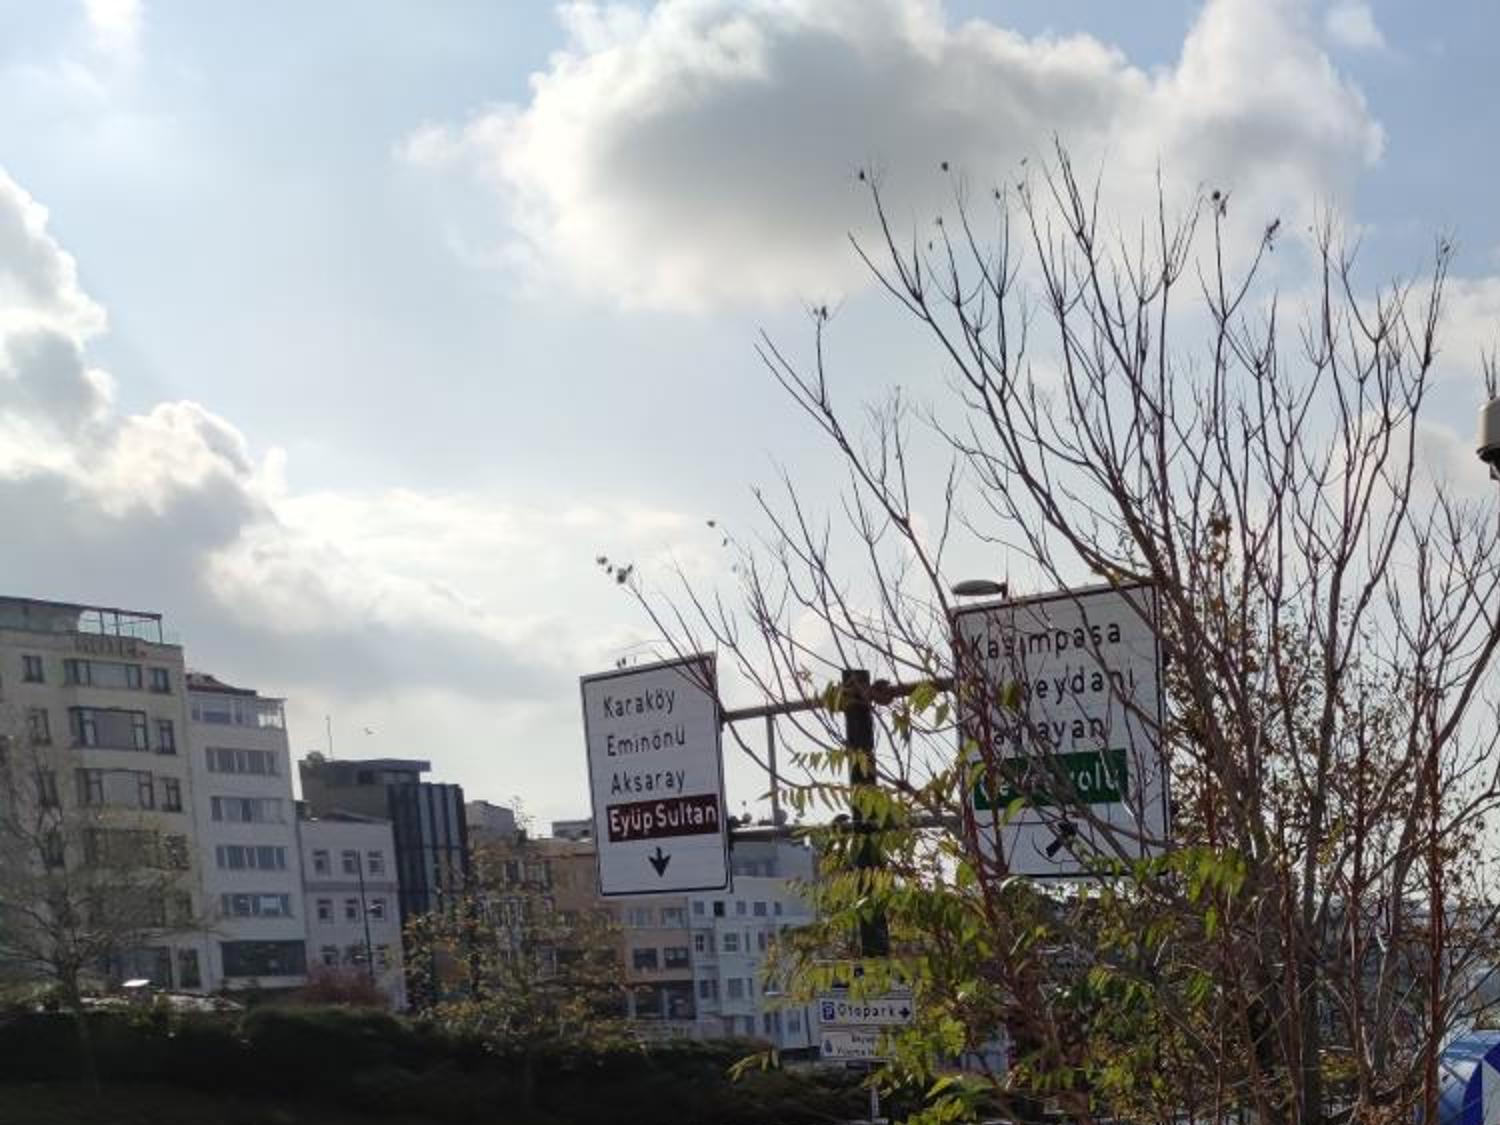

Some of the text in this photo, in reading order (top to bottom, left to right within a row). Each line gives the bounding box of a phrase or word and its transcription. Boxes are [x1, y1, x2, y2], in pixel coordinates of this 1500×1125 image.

[603, 687, 676, 718] Karaköy
[607, 724, 686, 757] Eminönü
[611, 769, 686, 795] Aksaray
